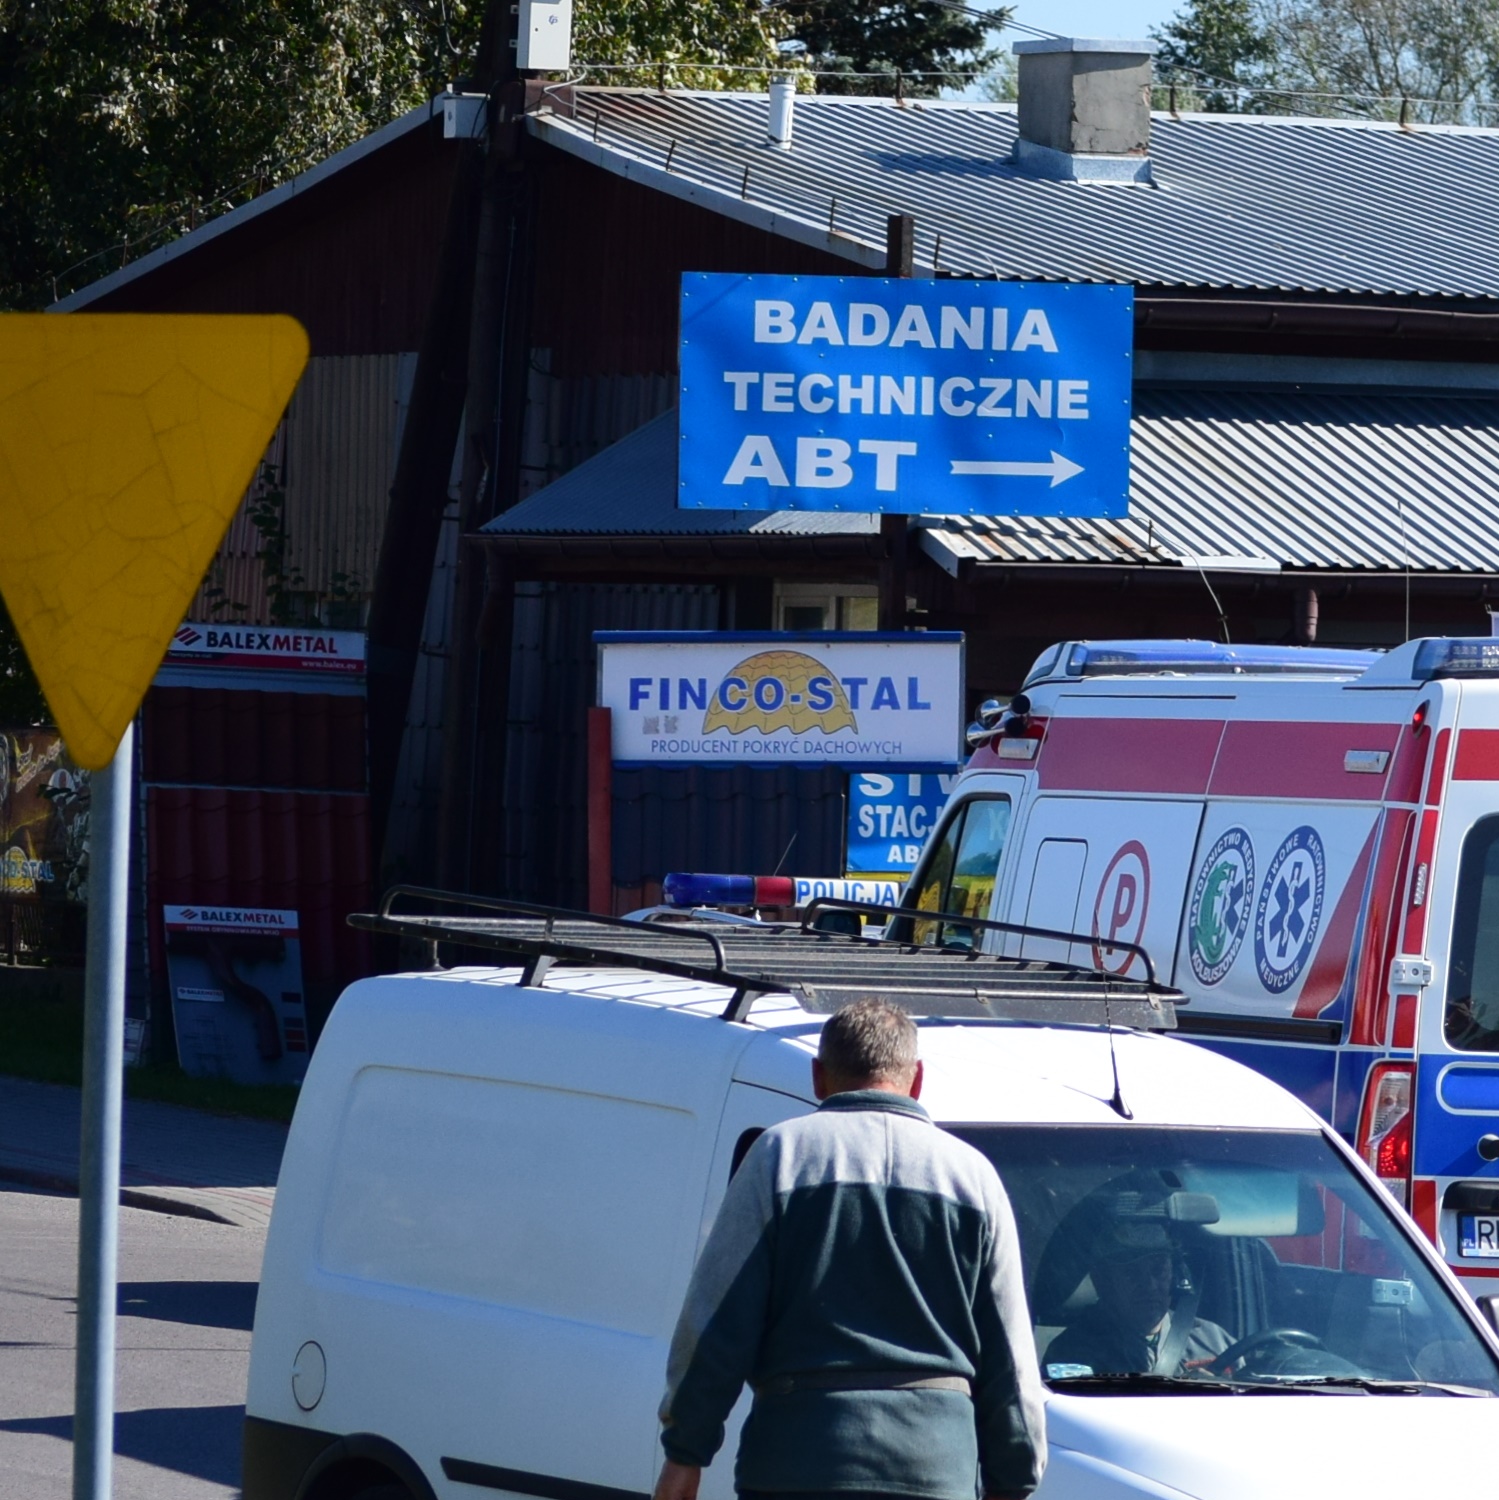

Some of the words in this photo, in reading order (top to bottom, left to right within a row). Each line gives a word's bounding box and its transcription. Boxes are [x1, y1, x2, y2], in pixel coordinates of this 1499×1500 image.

[754, 300, 1058, 353] BADANIA
[723, 371, 1089, 420] TECHNICZNE
[722, 435, 917, 491] ABT
[206, 631, 338, 654] BALEXMETAL
[629, 676, 931, 712] FINCO-STAL
[651, 739, 741, 754] PRODUCENT
[743, 736, 799, 754] POKRYĆ
[803, 741, 902, 755] DACHOWYCH
[887, 844, 924, 863] AB
[797, 880, 896, 907] POLICJA
[1191, 832, 1241, 927] RATOWNICTWO
[1240, 839, 1254, 932] MEDYCZNE
[1256, 834, 1299, 940] PAŃSTWOWE
[1307, 834, 1325, 943] RATOWNICTWO
[201, 911, 285, 924] BALEXMETAL
[1107, 873, 1136, 955] P
[1191, 938, 1241, 982] KOLBUSZOWA
[1260, 957, 1299, 988] MEDYCZNE
[1462, 1238, 1475, 1248] PL
